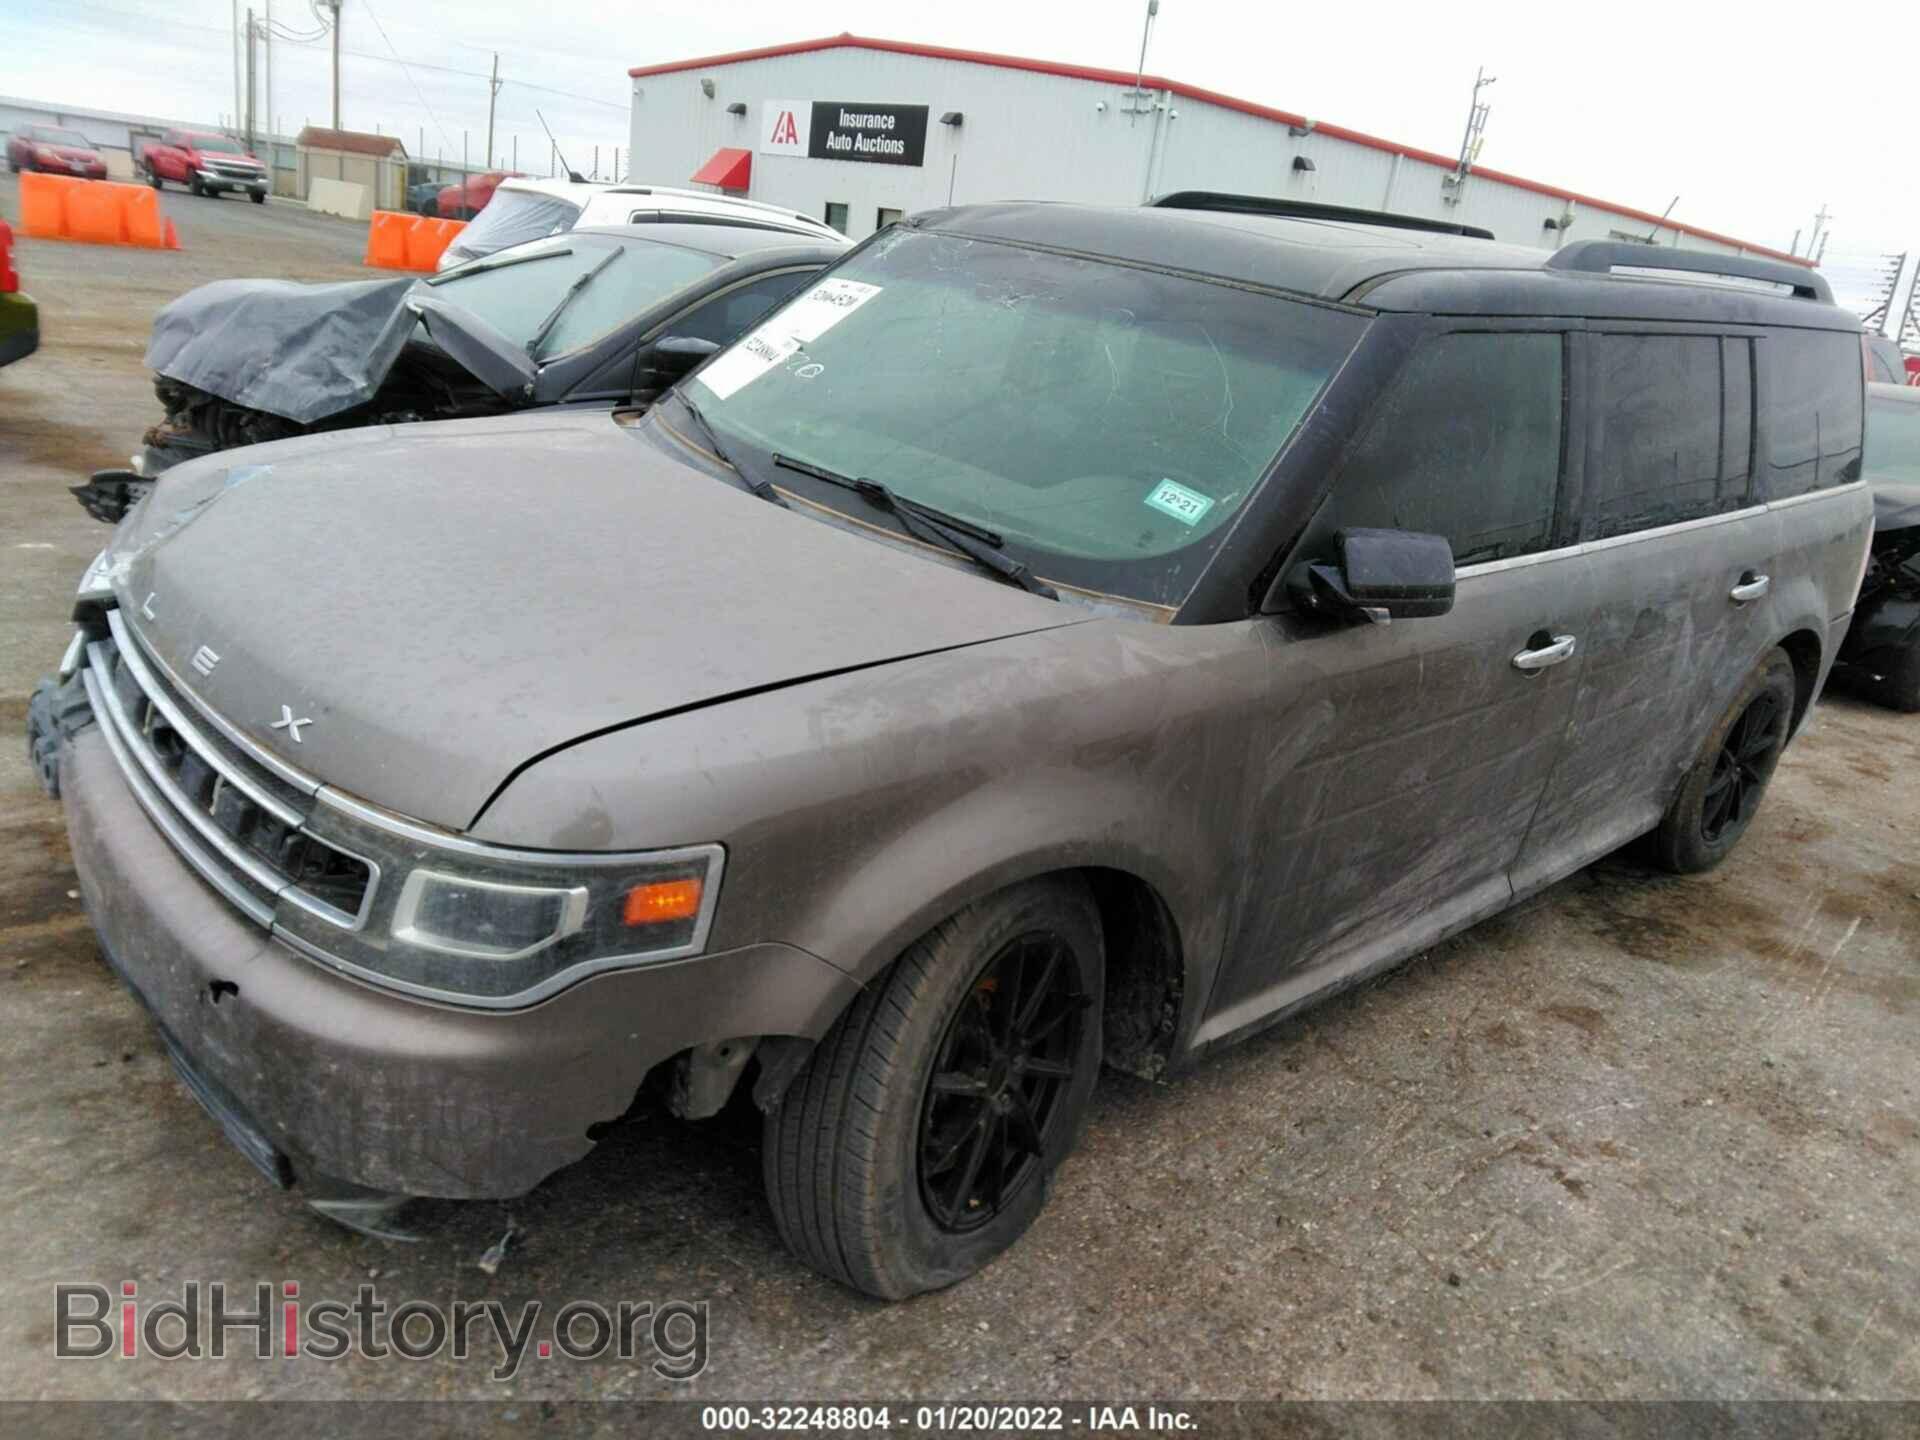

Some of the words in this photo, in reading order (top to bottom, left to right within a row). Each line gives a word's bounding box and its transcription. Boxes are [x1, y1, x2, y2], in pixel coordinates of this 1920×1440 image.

[839, 108, 895, 130] Insurance
[826, 131, 852, 150] Auto
[854, 132, 904, 154] Auctions
